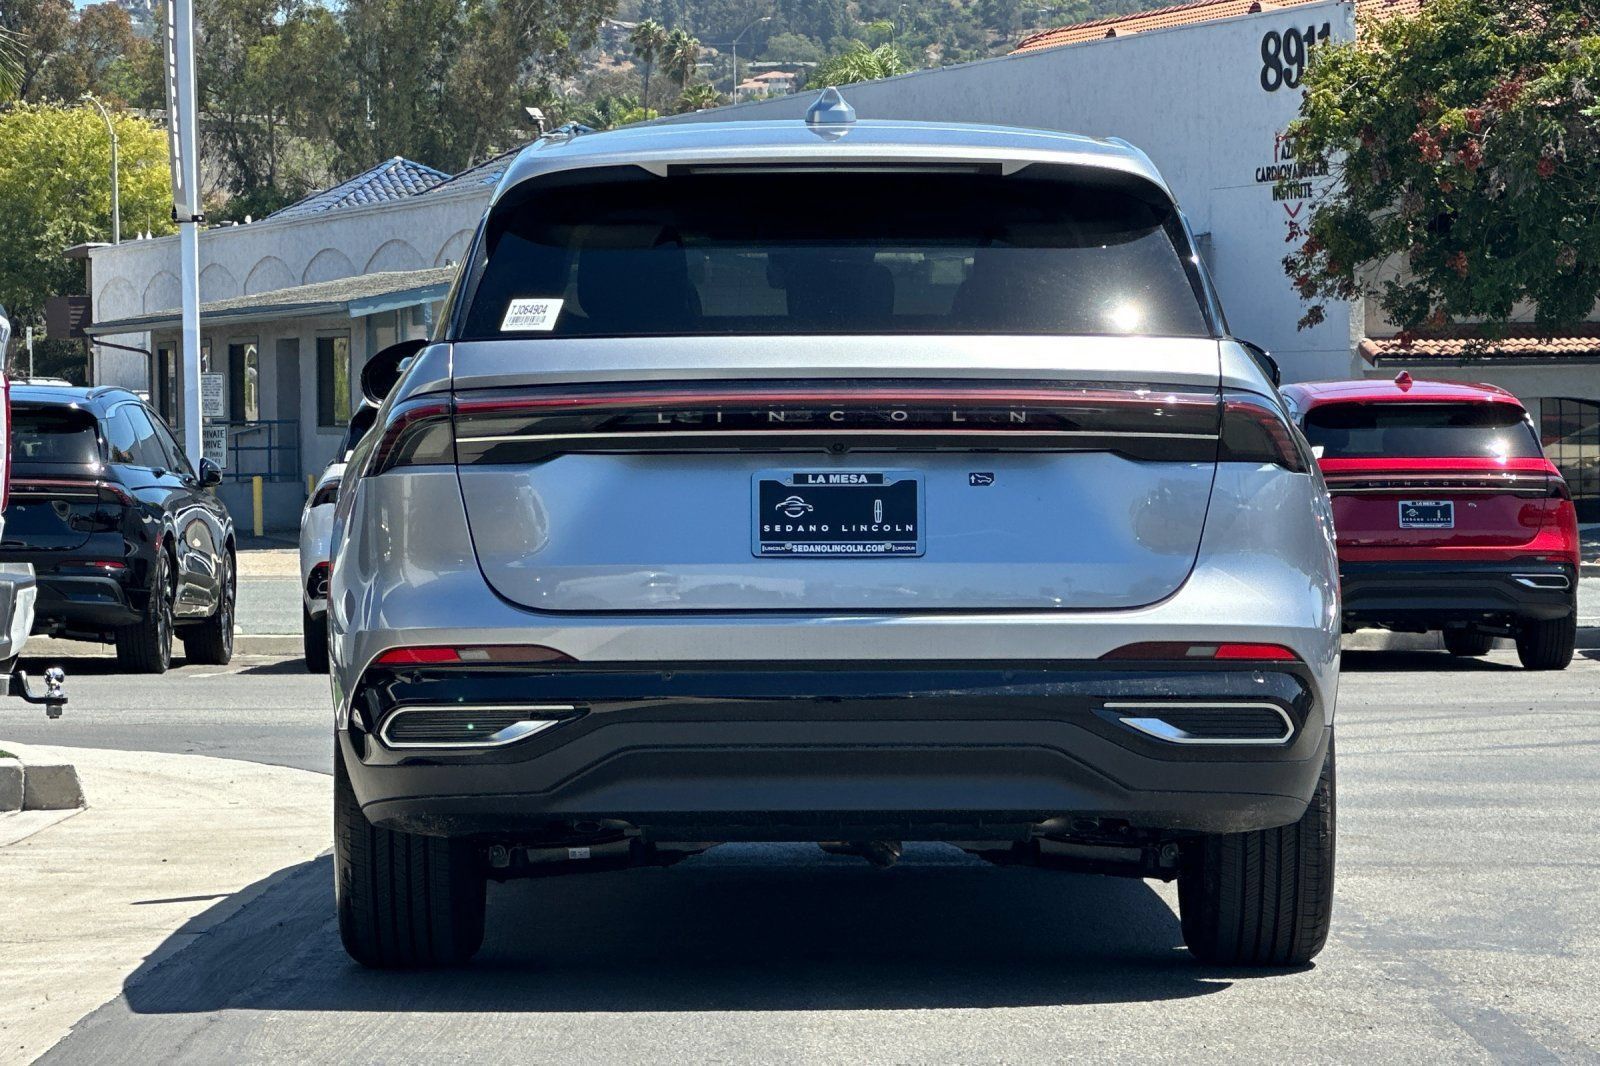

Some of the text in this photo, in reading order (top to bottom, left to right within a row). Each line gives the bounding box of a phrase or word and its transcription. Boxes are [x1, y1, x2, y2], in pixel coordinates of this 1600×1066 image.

[1256, 158, 1329, 183] CARDIOVAULAR
[511, 304, 549, 315] TJ064904
[657, 410, 1027, 423] LINCOLN
[203, 430, 225, 438] RIVATE
[807, 474, 868, 484] LA MESA
[763, 524, 913, 532] SEDANO LINCOLN
[792, 544, 885, 553] SEDANOLINCOLN.COM
